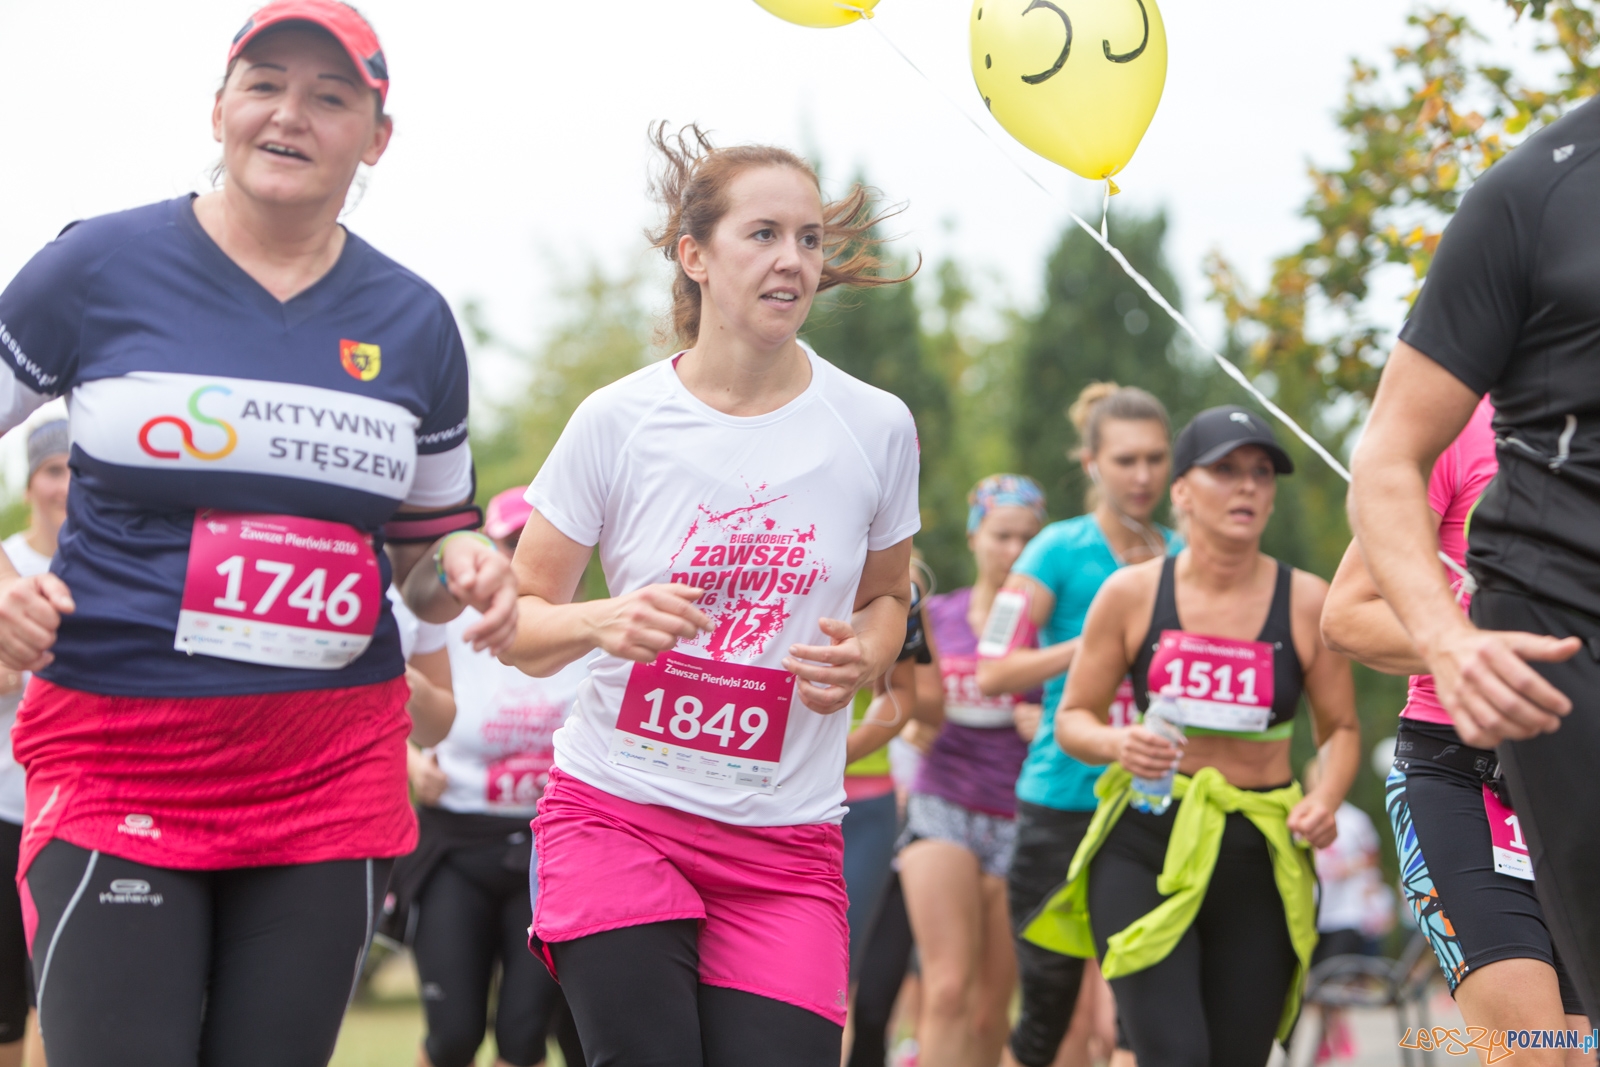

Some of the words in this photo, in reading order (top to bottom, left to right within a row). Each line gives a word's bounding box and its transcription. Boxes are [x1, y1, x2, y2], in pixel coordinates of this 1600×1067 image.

[240, 399, 397, 443] AKTYWNY
[268, 437, 408, 483] STĘSZEW
[239, 526, 284, 545] Zawsze
[332, 540, 359, 556] 2016
[690, 544, 806, 568] zawsze
[729, 533, 754, 544] BIEG
[755, 533, 794, 545] KOBIET
[213, 555, 363, 627] 1746
[664, 663, 700, 681] Zawsze
[700, 672, 741, 688] Pier(w)si
[741, 679, 767, 691] 2016
[1164, 657, 1259, 705] 1511
[639, 687, 769, 751] 1849
